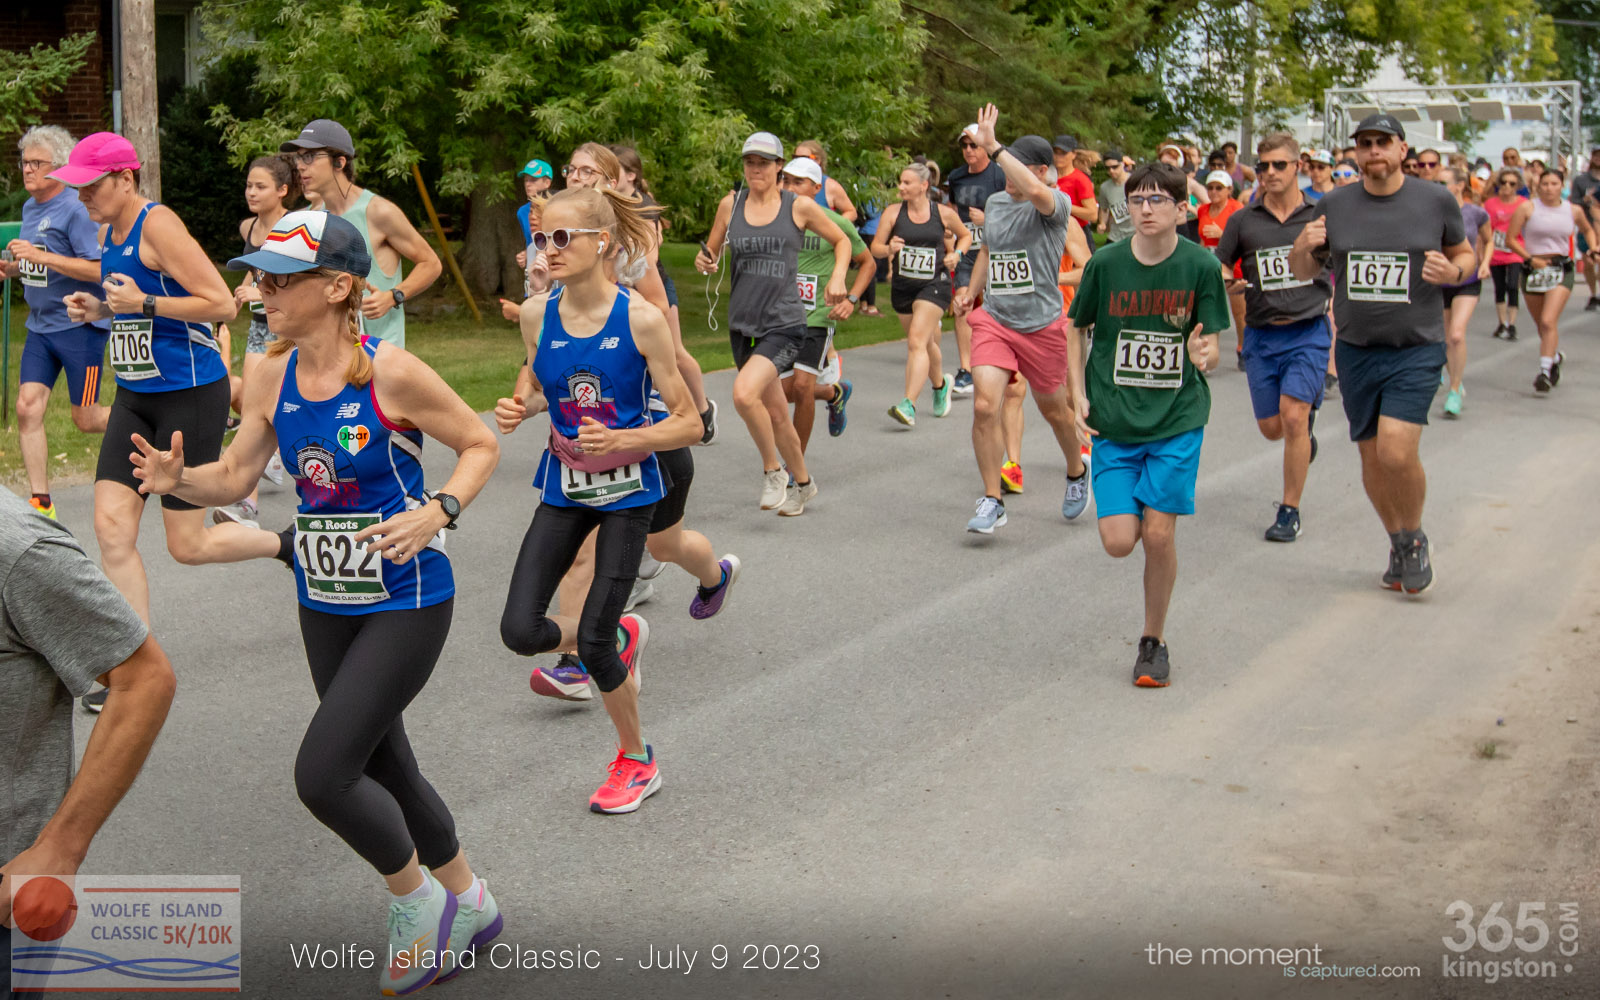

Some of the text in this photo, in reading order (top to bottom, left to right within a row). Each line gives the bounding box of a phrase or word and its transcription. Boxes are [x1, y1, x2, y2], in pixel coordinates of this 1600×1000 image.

[732, 236, 786, 255] HEAVILY
[902, 254, 934, 270] 1774
[991, 260, 1030, 282] 1789
[1352, 264, 1406, 286] 1677
[1108, 289, 1195, 317] ACADEMIA
[112, 333, 150, 361] 1706
[1148, 335, 1173, 343] Roots
[1120, 342, 1180, 371] 1631
[339, 431, 368, 441] Dbar
[596, 488, 608, 496] 5k
[324, 519, 359, 530] Roots
[299, 534, 377, 578] 1622
[334, 583, 347, 592] 5k
